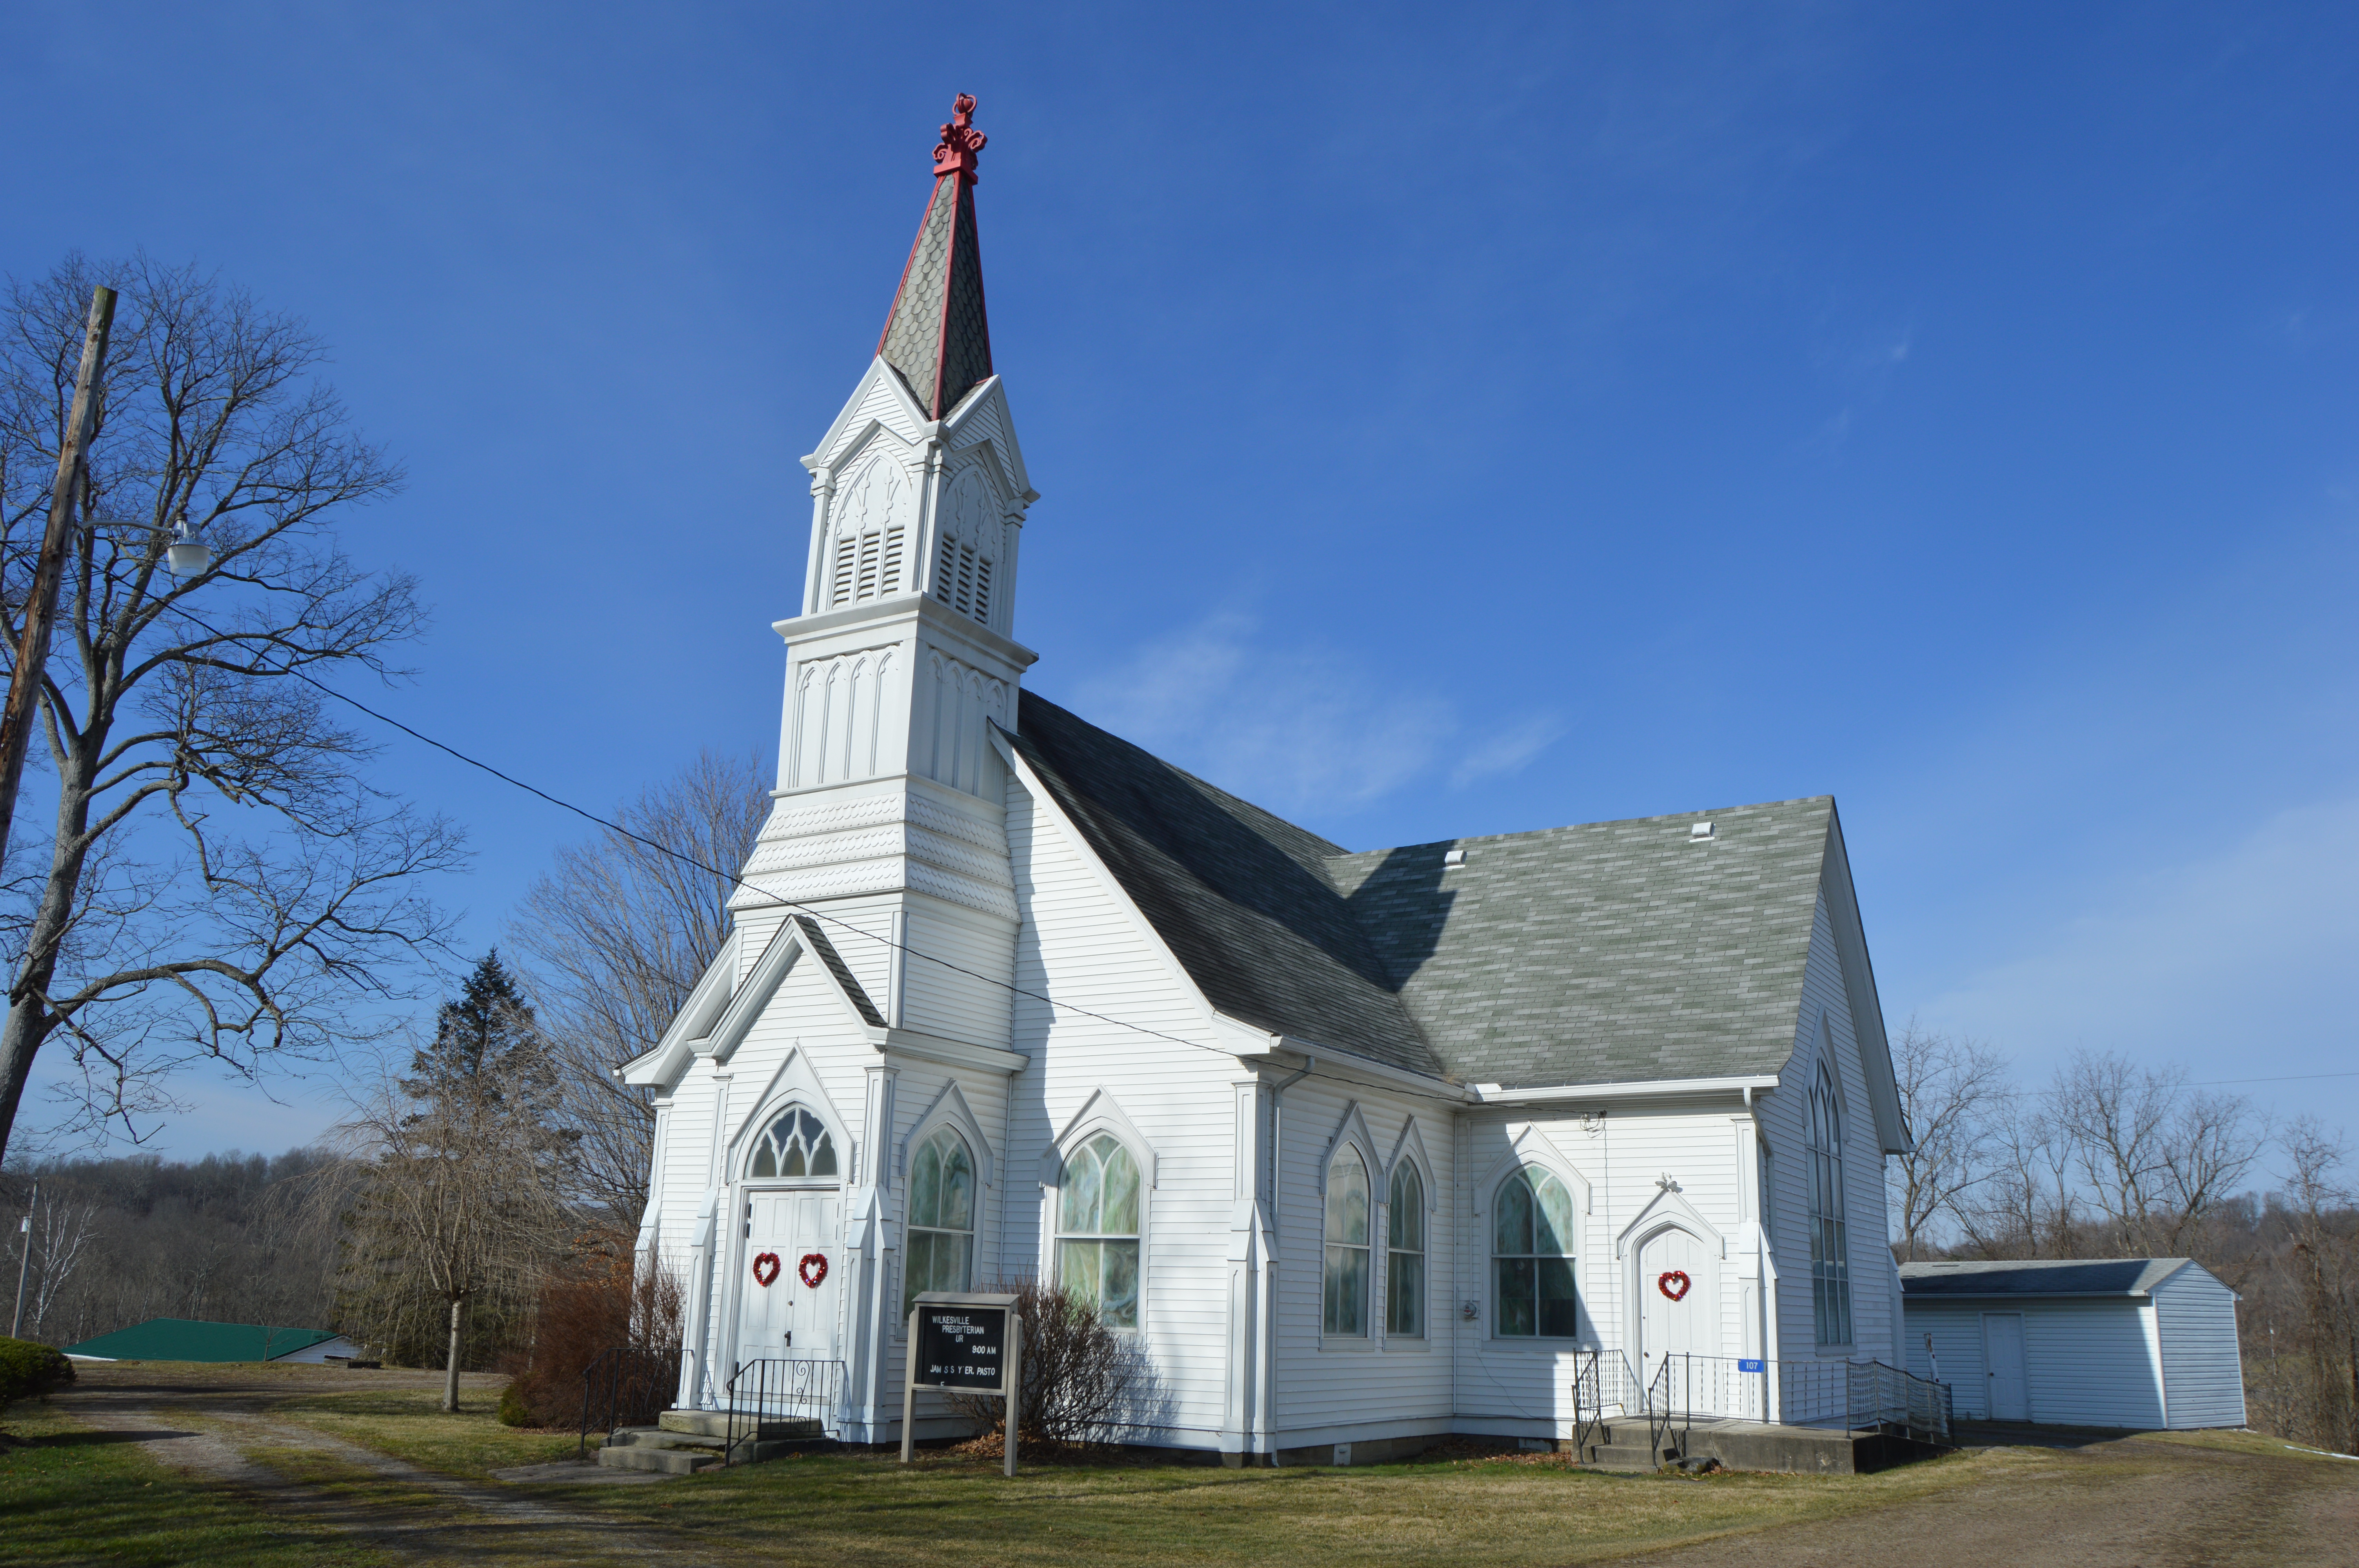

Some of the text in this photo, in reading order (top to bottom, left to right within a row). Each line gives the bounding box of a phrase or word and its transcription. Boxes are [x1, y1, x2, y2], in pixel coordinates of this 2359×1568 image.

[932, 1316, 969, 1325] WILKESVILLE
[942, 1325, 984, 1334] PRESBYTERIAN
[972, 1345, 985, 1354] 9:00
